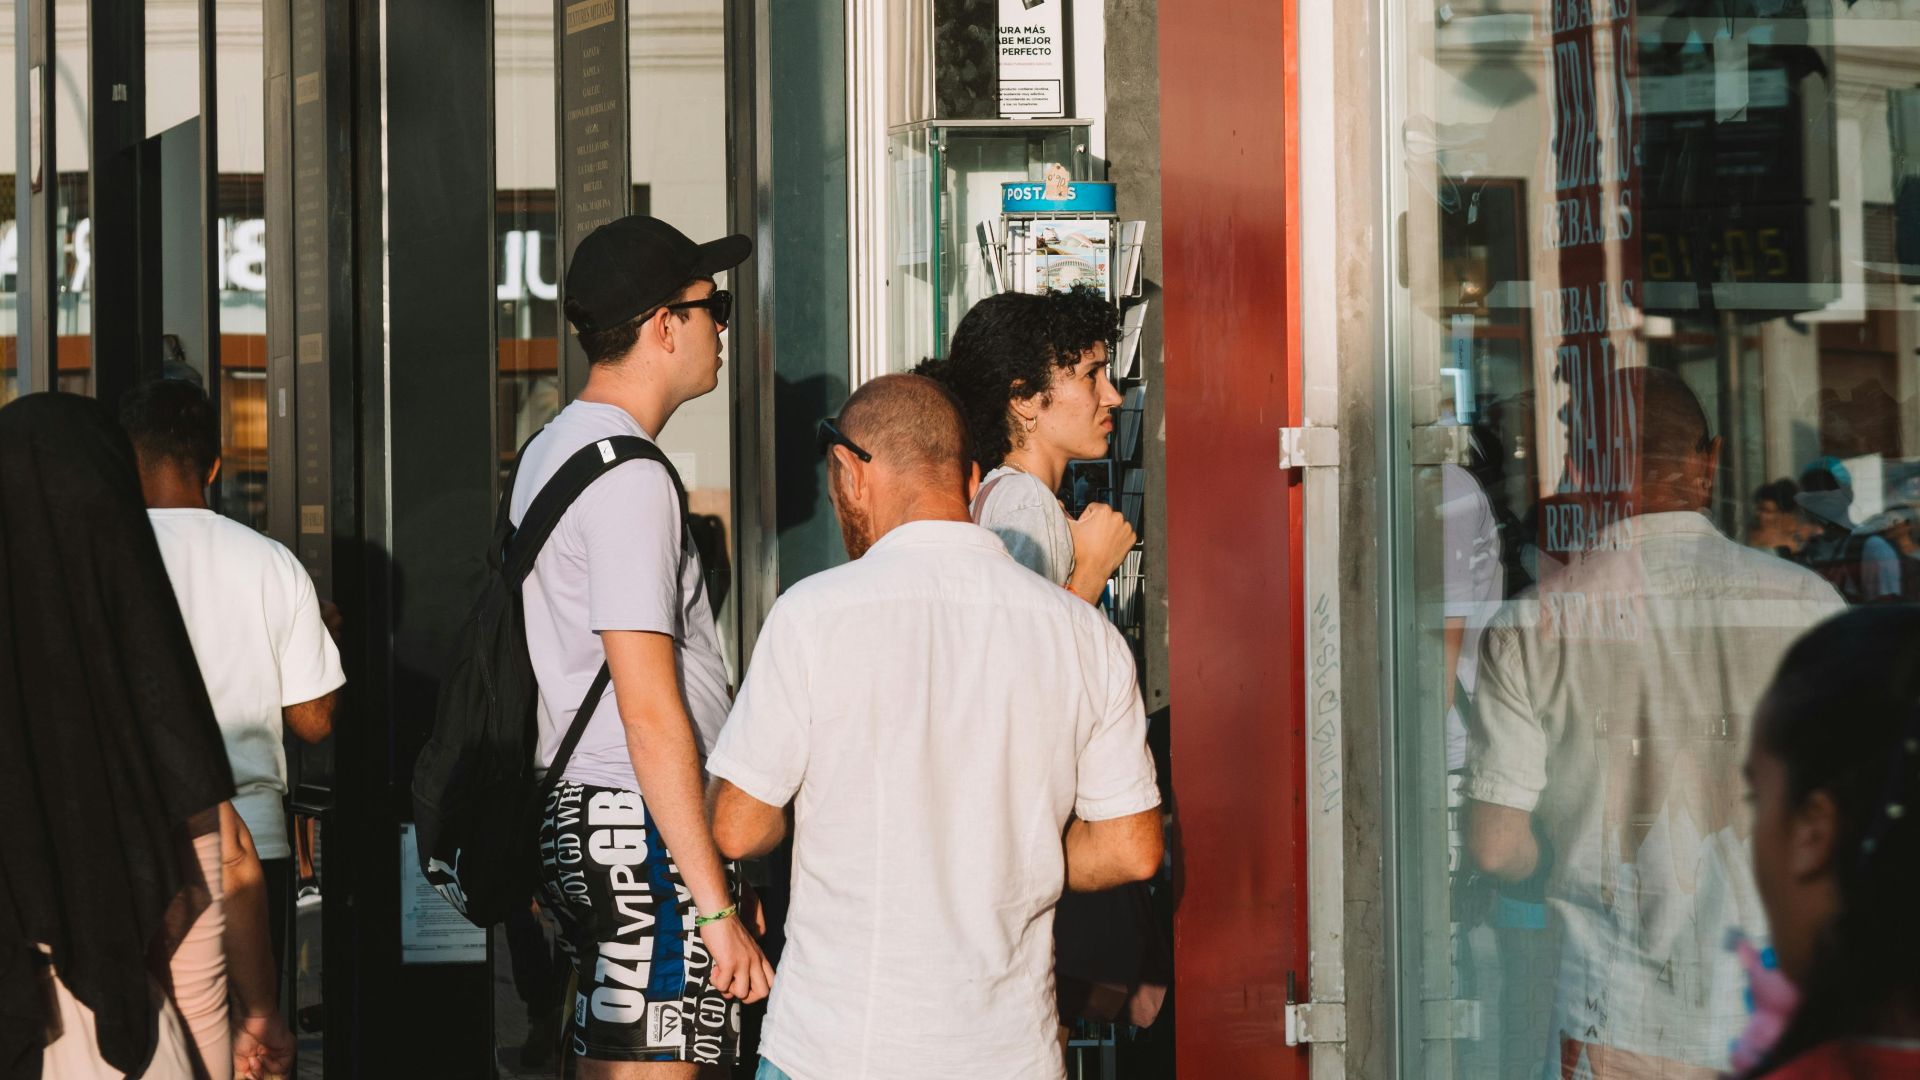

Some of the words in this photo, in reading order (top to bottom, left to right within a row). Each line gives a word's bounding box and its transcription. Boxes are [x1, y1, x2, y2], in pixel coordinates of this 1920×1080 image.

[1017, 36, 1051, 45] MEJOR
[1024, 24, 1046, 34] MÁS
[1002, 47, 1052, 56] PERFECTO
[1007, 186, 1077, 201] POSTS
[1542, 190, 1632, 249] REBAJAS
[1542, 280, 1634, 337] REBAJAS
[1544, 336, 1637, 495] REBAJAS
[1545, 502, 1634, 552] REBAJAS
[558, 833, 583, 864] GD
[699, 997, 726, 1028] GD
